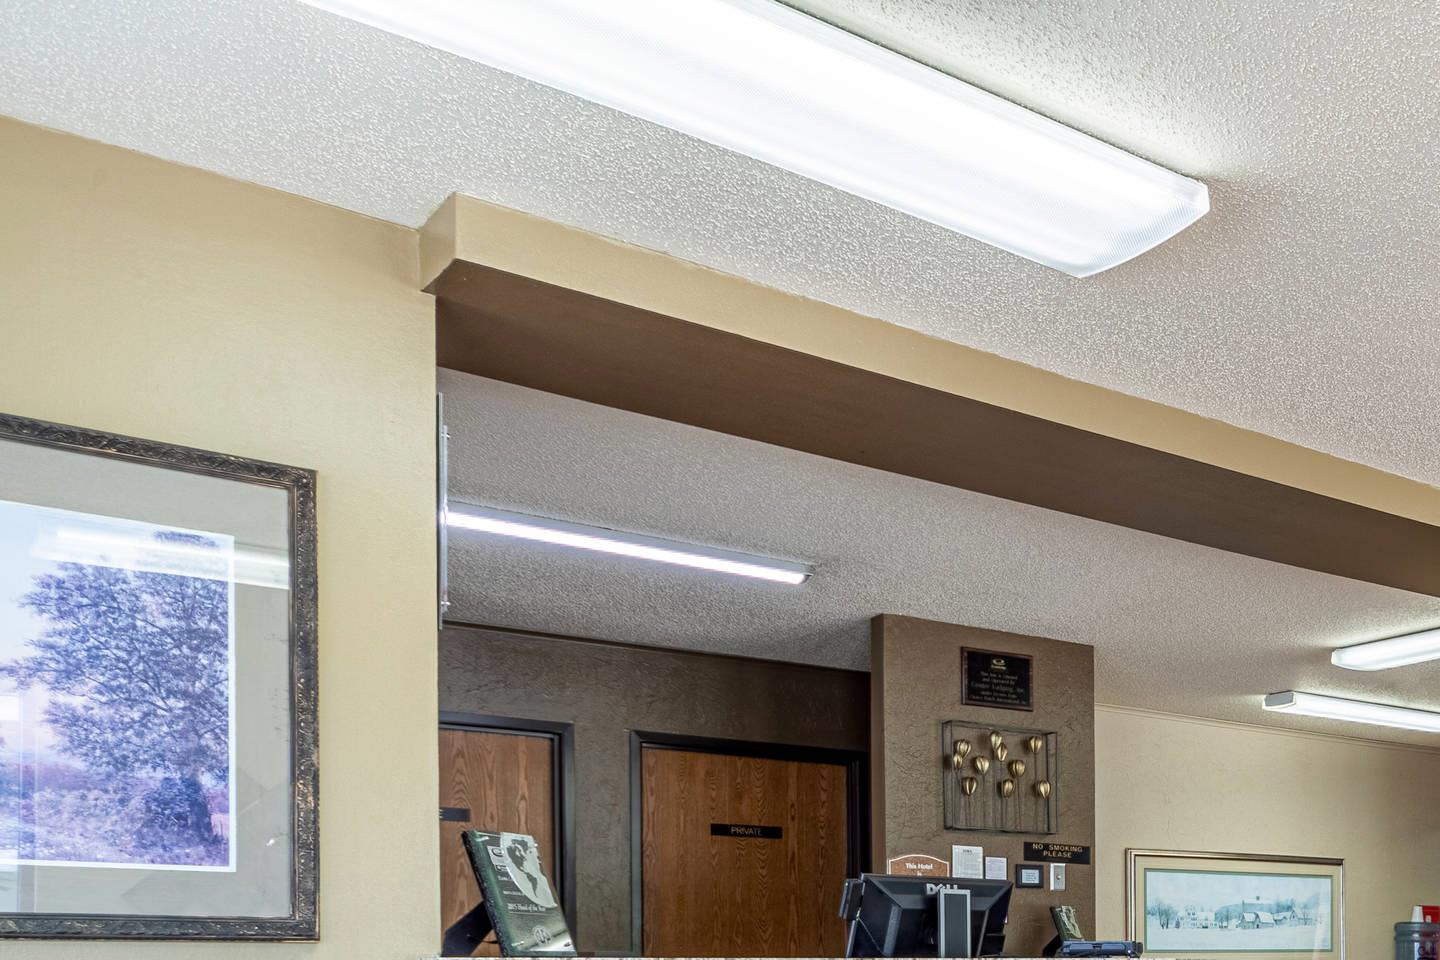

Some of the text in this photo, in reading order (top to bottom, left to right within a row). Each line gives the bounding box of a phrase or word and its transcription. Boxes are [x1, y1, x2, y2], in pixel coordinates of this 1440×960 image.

[730, 826, 762, 836] PRIVATE
[1049, 844, 1083, 853] SMOKING
[1043, 850, 1072, 858] PLEASE
